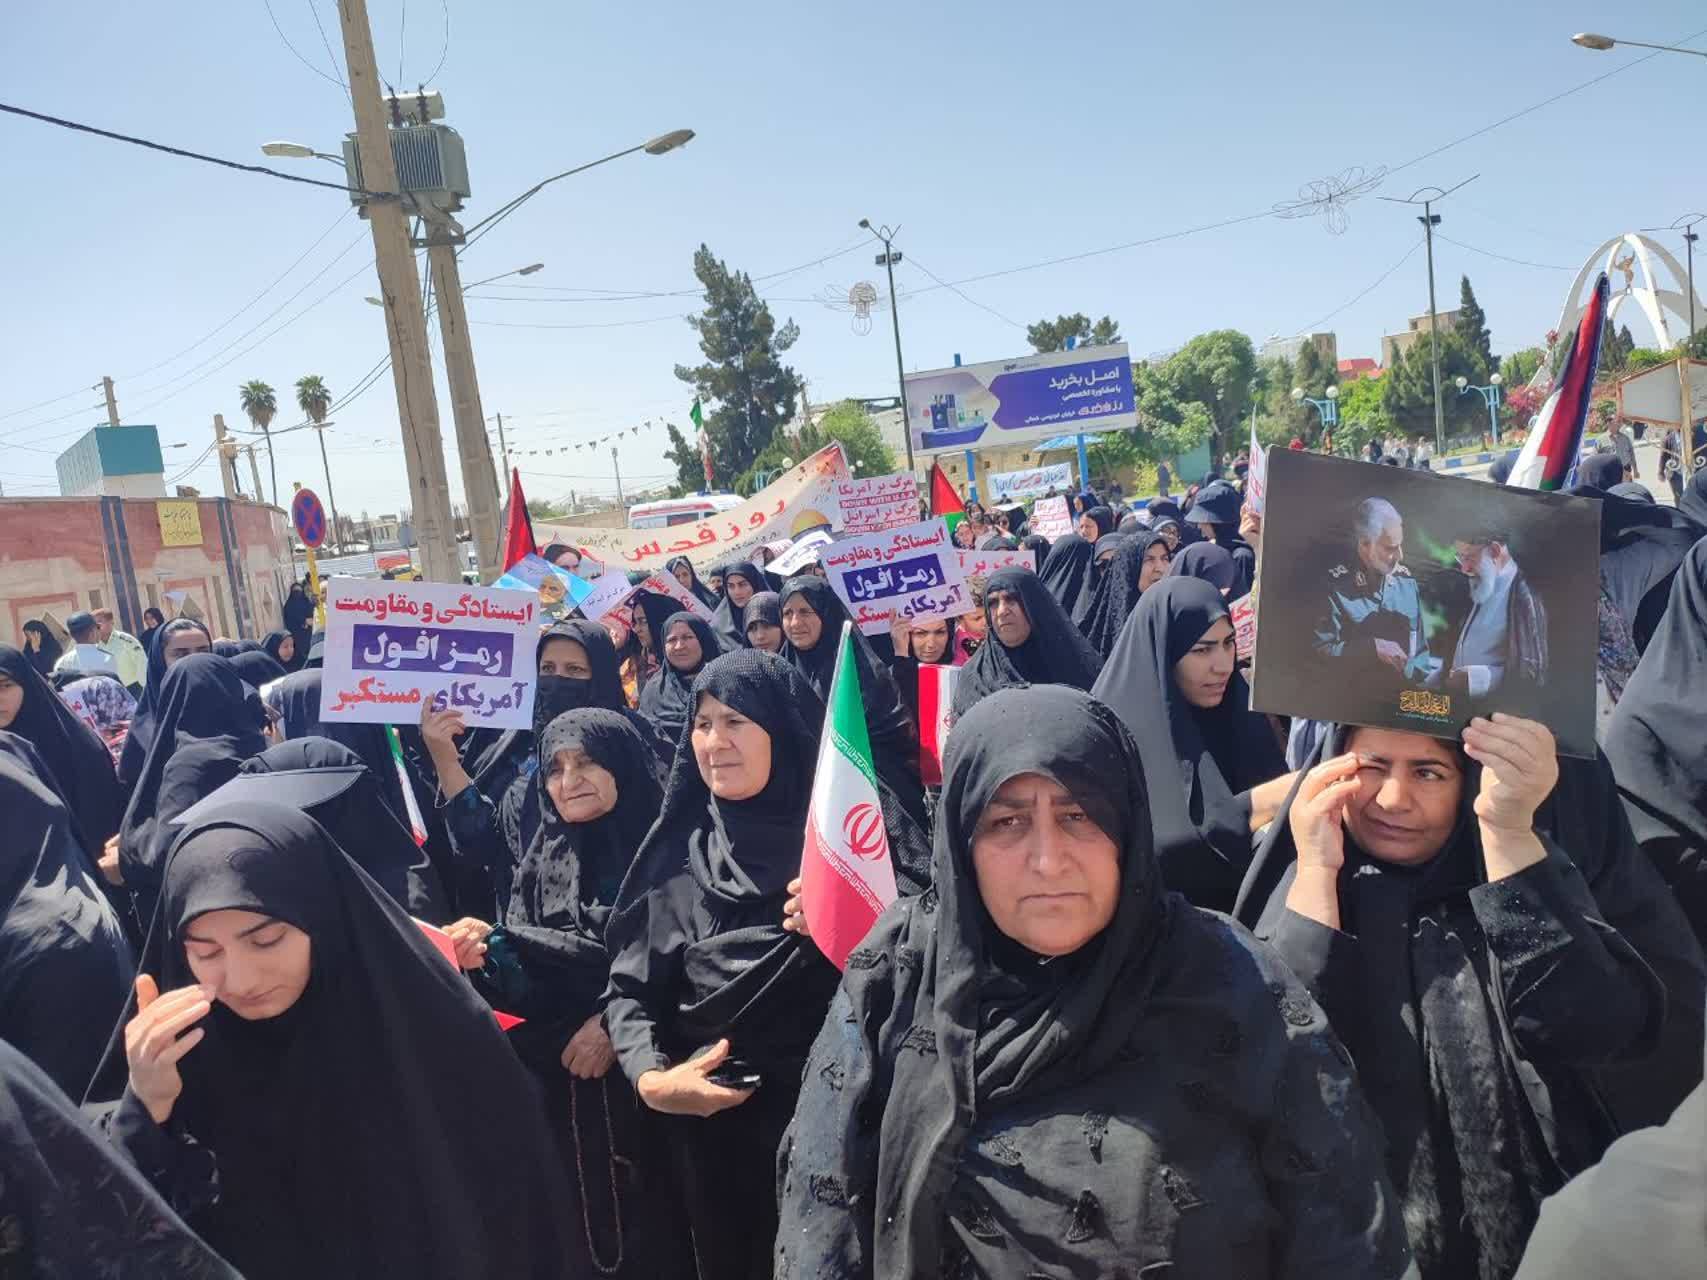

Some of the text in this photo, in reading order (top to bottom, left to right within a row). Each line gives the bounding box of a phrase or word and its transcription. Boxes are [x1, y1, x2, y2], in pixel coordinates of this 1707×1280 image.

[1049, 366, 1120, 389] اصل بخرید
[622, 500, 786, 561] روز قدس
[884, 526, 945, 560] ایستادگی
[826, 546, 872, 566] مقاومت
[875, 548, 882, 561] و
[852, 568, 938, 600] رمز افول
[335, 592, 533, 626] ایستادگی و مقاومت
[898, 584, 962, 619] آمریکای
[363, 630, 502, 674] رمز افول
[329, 676, 529, 717] آمریکای مستکبر
